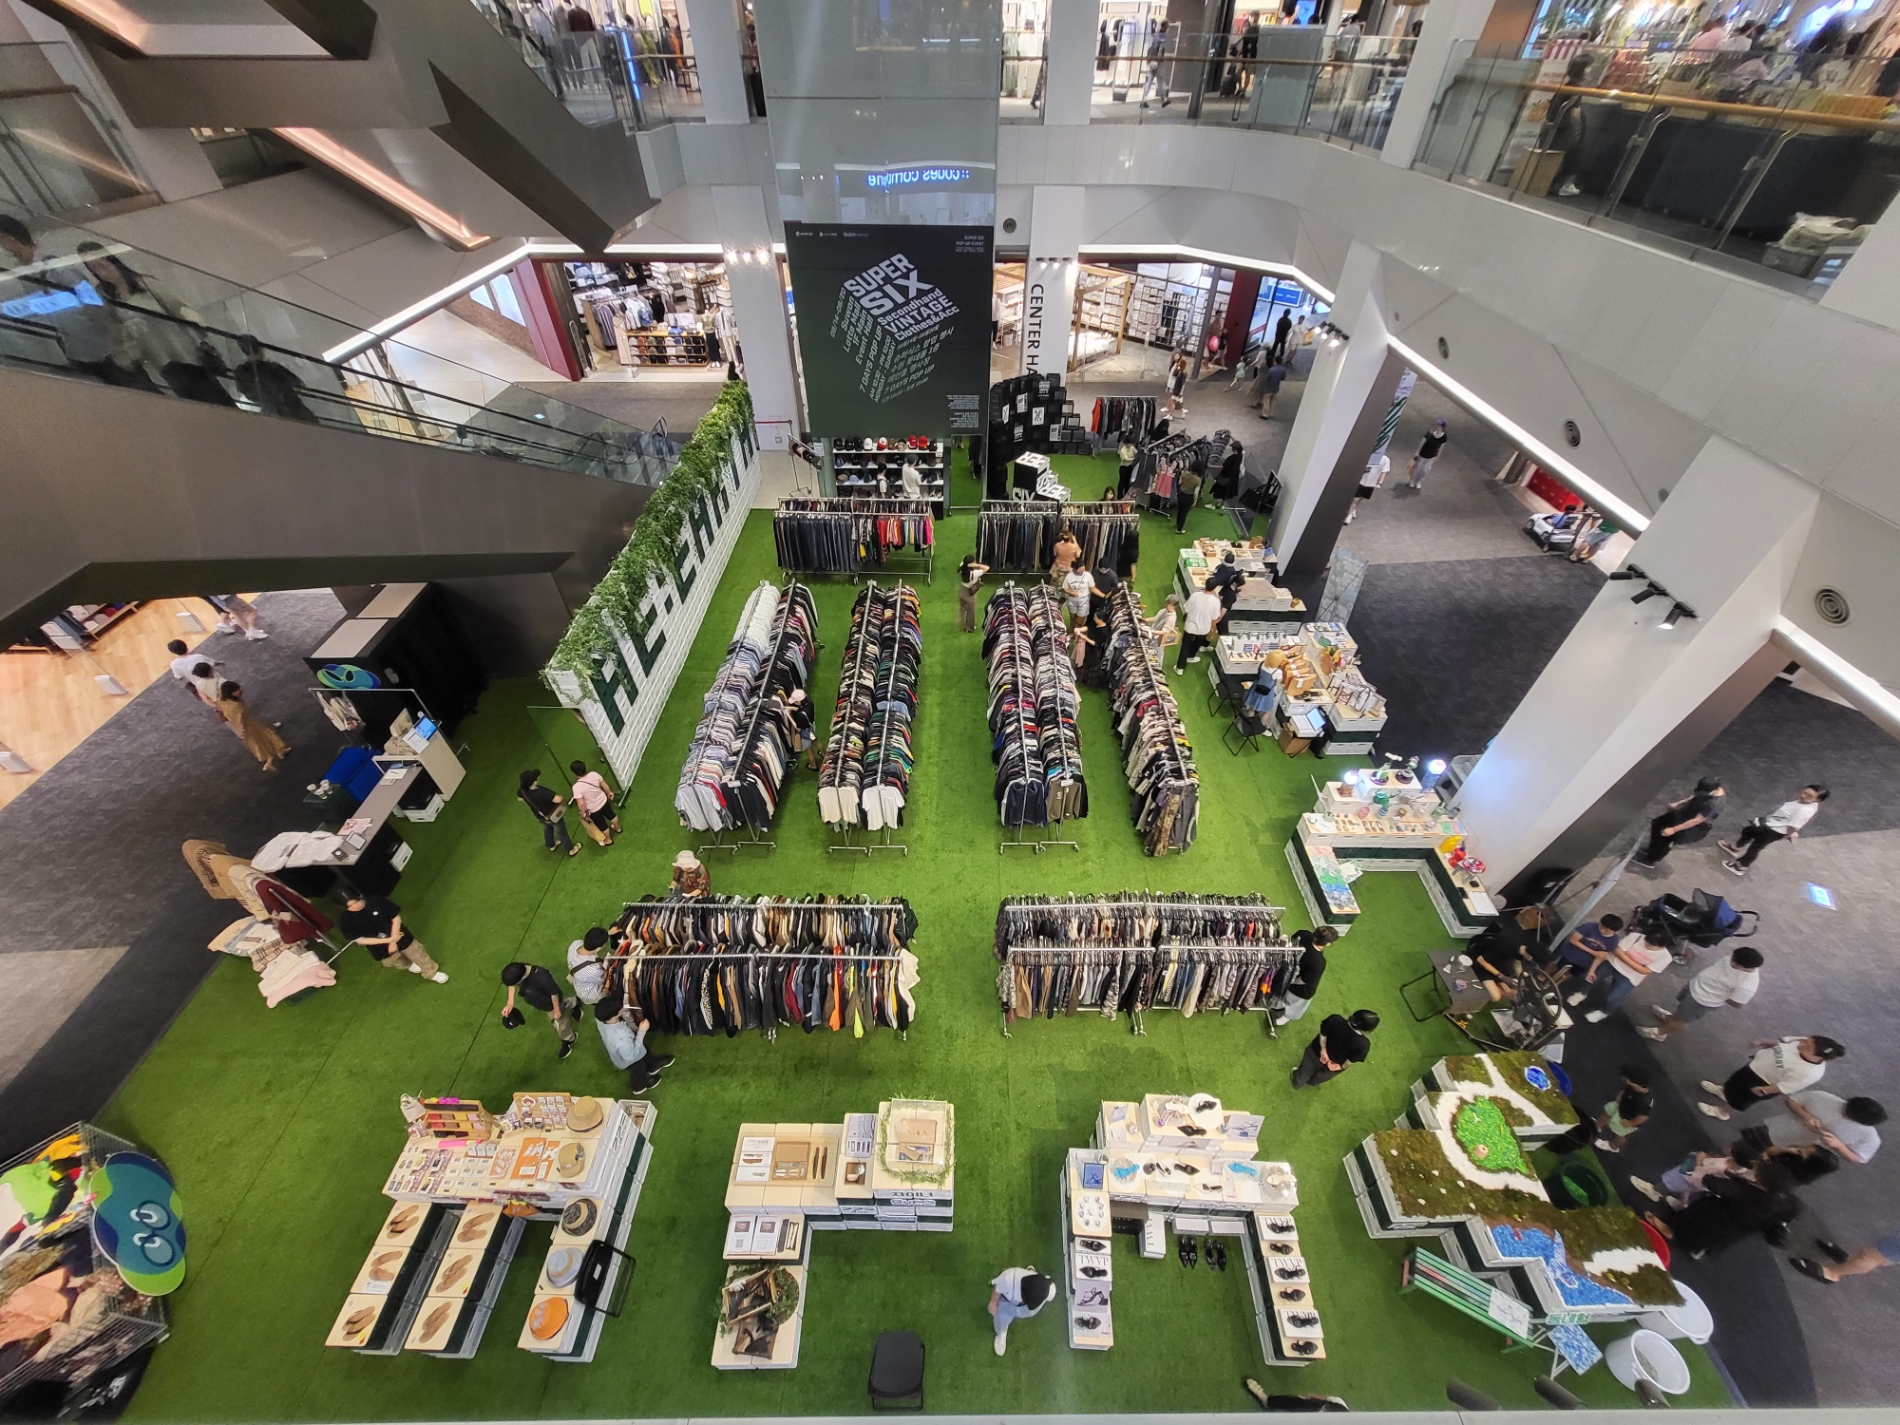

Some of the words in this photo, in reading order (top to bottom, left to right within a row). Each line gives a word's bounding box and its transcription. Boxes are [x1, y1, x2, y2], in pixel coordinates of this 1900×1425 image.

[843, 253, 915, 297] SUPER
[859, 269, 934, 316] SIX
[841, 296, 854, 331] Suwon
[850, 300, 862, 325] Mall
[877, 288, 943, 325] Secondhand
[884, 295, 953, 333] VINTAGE
[895, 306, 960, 340] Clothes&Acc
[1027, 283, 1044, 350] CENTER
[852, 333, 860, 346] 1F
[856, 309, 867, 335] Main
[855, 335, 868, 365] Event
[863, 315, 873, 336] Hall
[875, 324, 882, 341] UP
[868, 339, 880, 361] POP
[860, 384, 866, 393] 7
[861, 359, 873, 386] DAYS
[874, 373, 886, 403] MONDAY
[884, 339, 897, 370] SUNDAY
[890, 377, 908, 392] DAYS
[909, 370, 924, 382] POP
[924, 364, 935, 375] UP
[1078, 1255, 1109, 1266] TWVP
